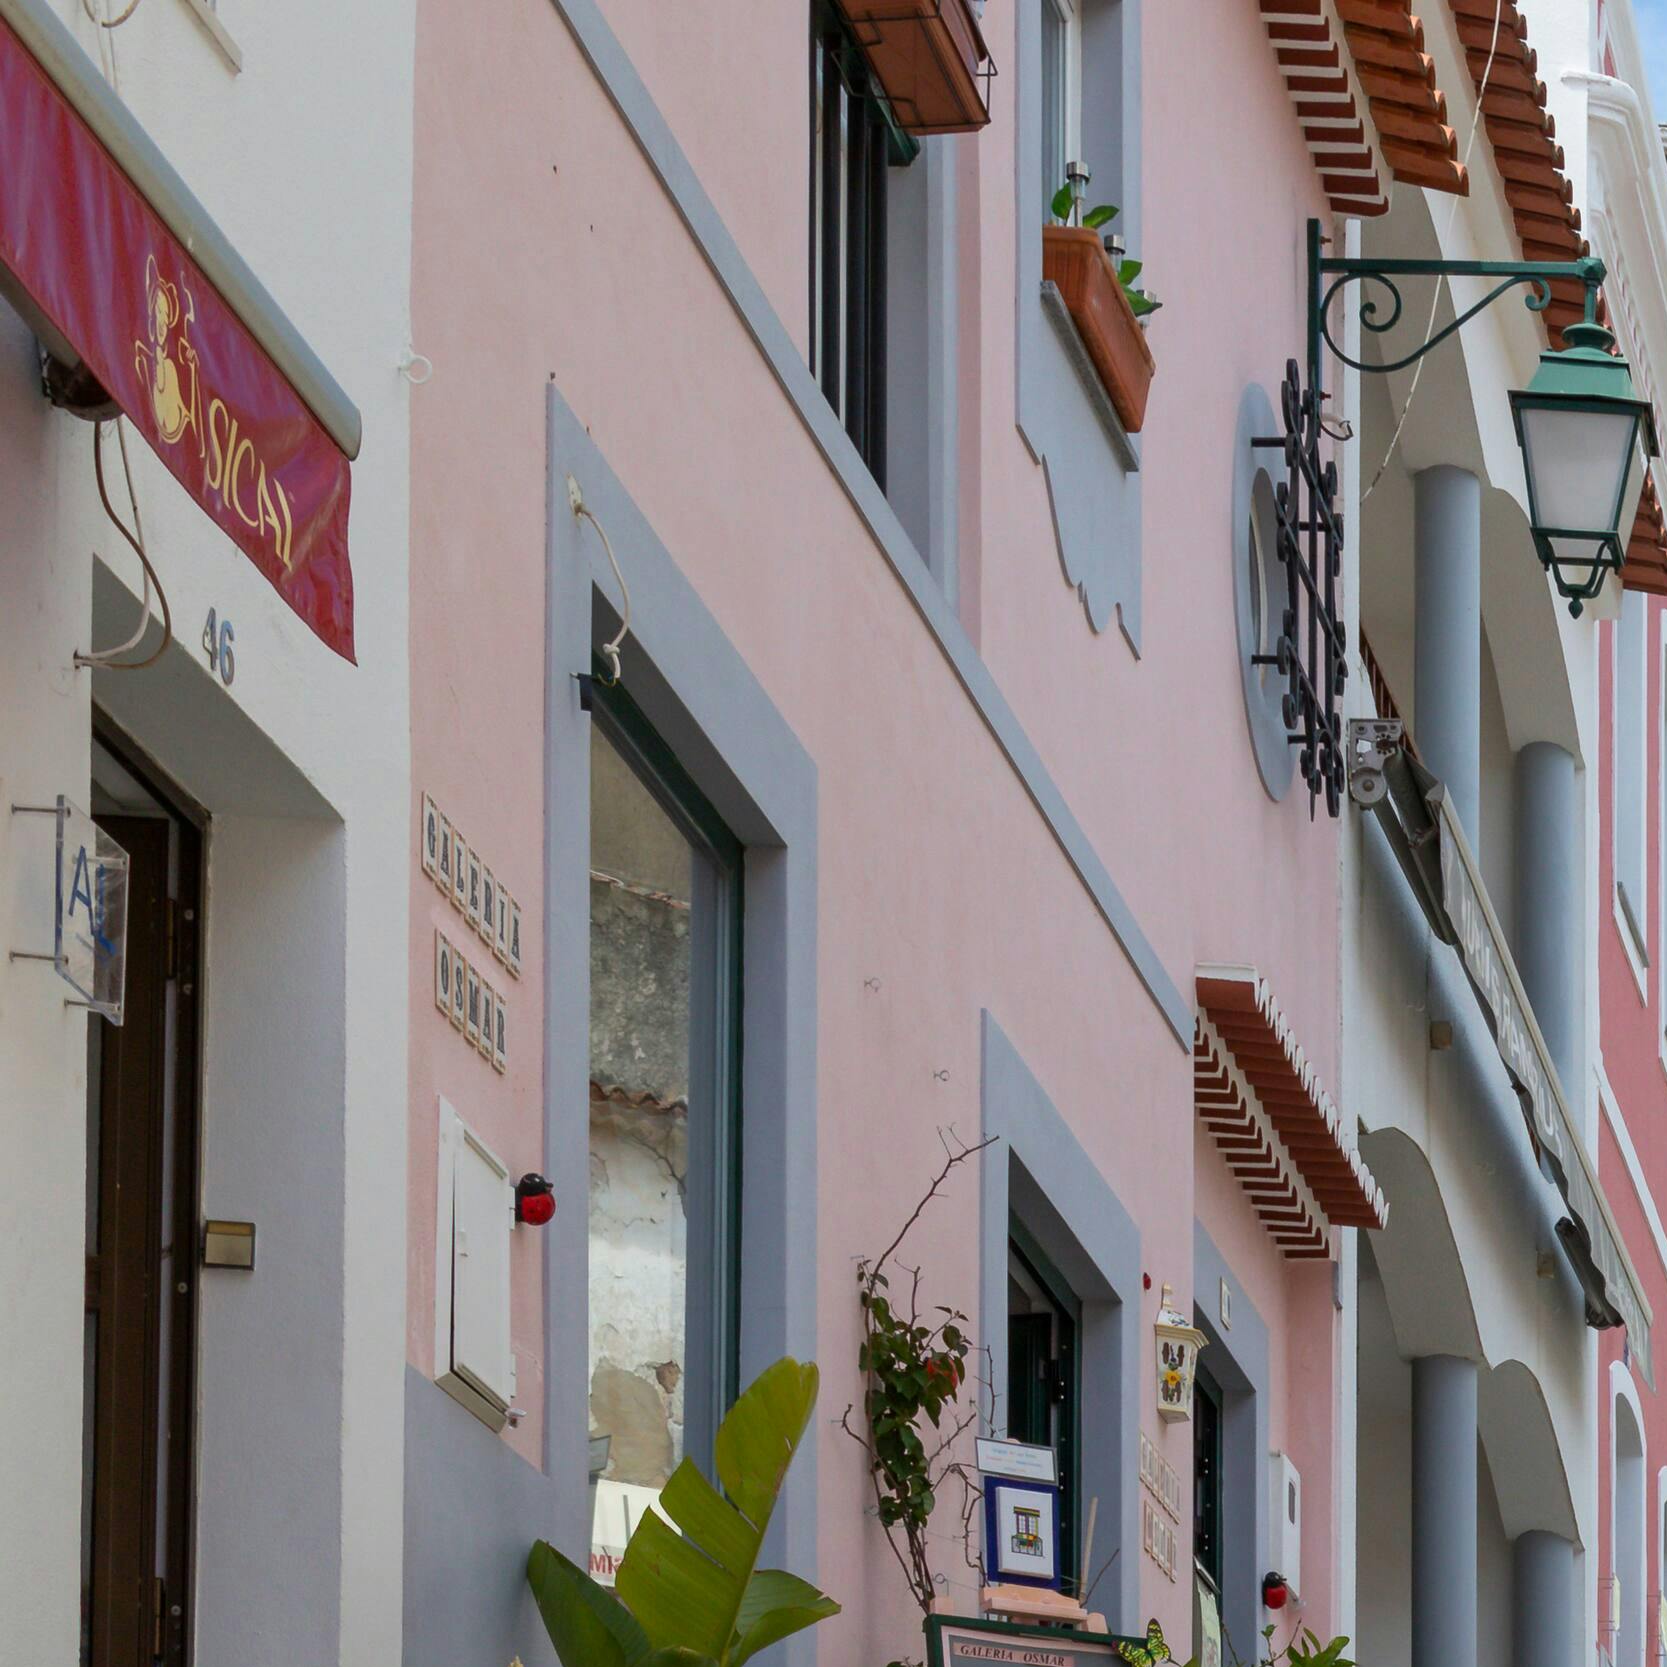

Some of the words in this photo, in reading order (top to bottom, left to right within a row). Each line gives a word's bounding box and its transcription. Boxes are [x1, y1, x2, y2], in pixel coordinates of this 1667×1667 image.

[202, 606, 235, 686] 46
[427, 812, 521, 963] GALERIA
[440, 949, 506, 1055] OSMAR
[960, 1644, 1013, 1661] GALERIA
[1023, 1652, 1066, 1667] OSMAR
